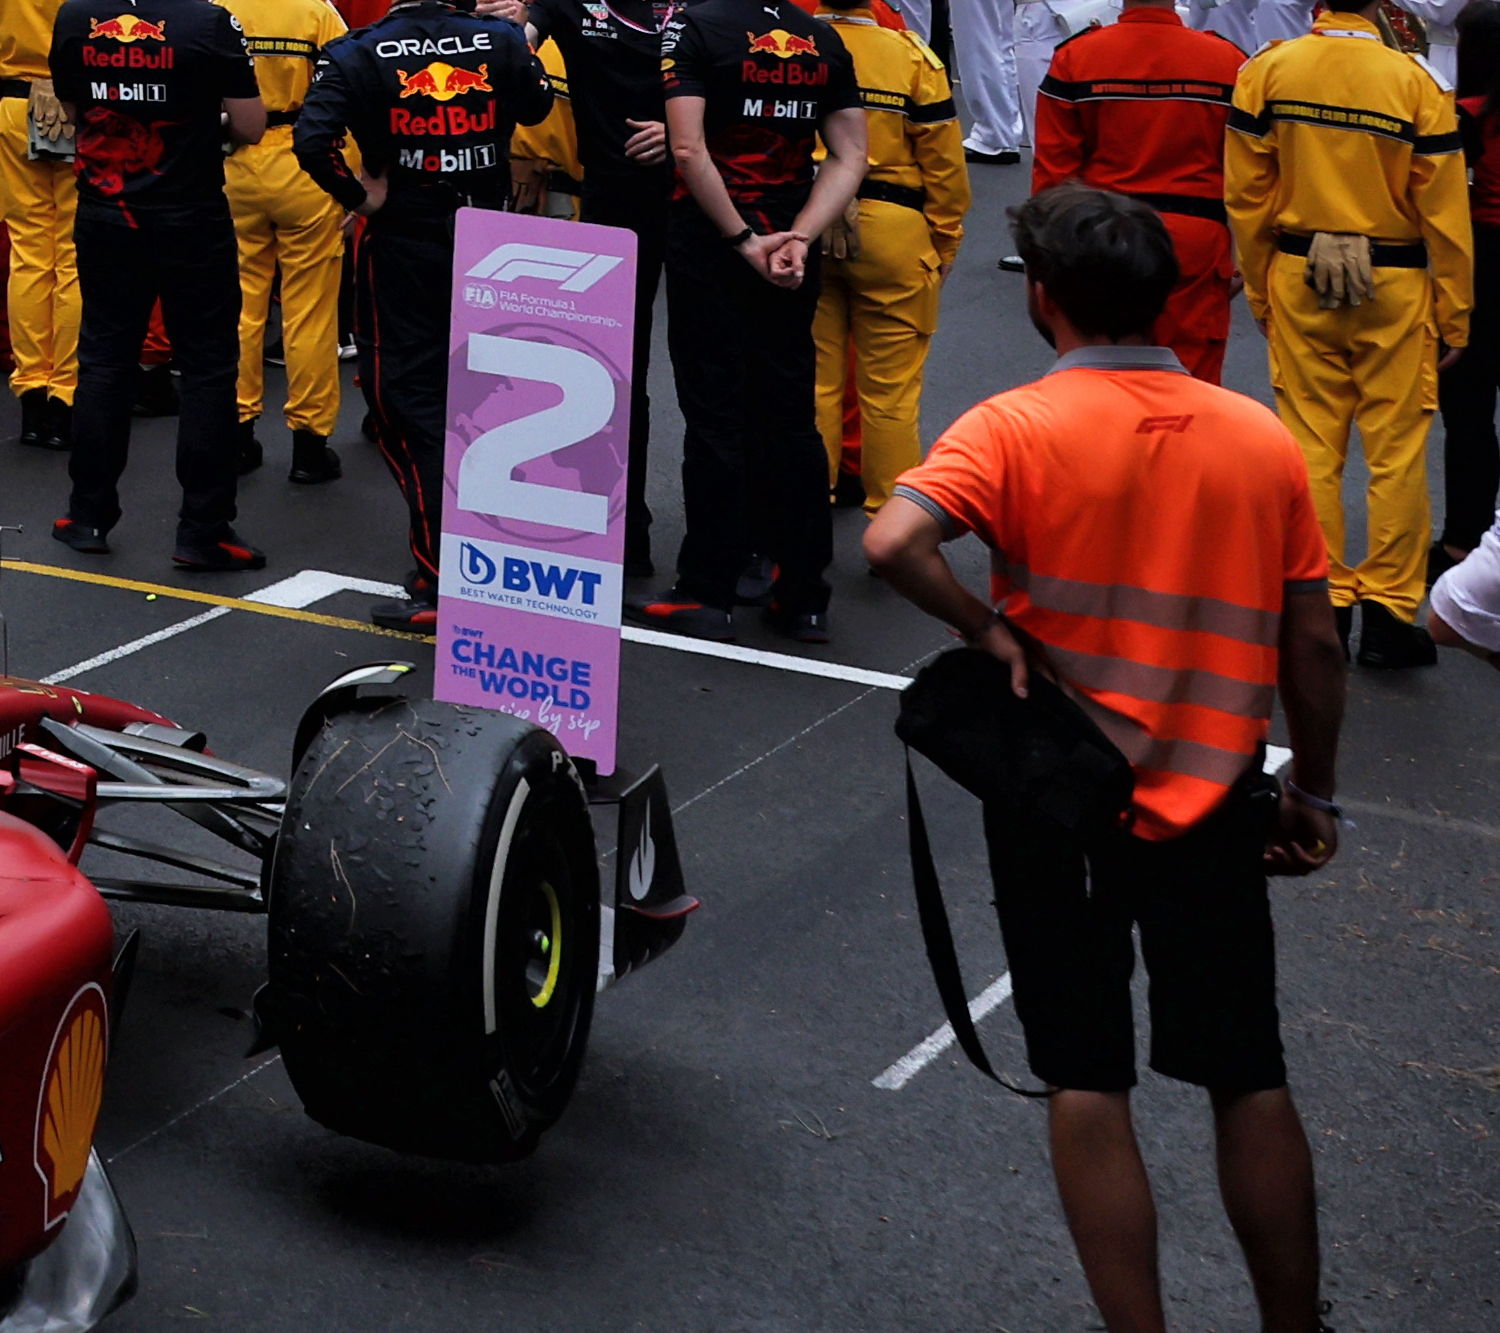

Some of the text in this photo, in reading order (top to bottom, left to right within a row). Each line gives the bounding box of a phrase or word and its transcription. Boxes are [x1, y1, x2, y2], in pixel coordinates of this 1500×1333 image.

[83, 45, 175, 70] Red Bull
[376, 32, 492, 59] ORACLE
[742, 61, 829, 86] Red Bull
[91, 81, 145, 102] Mobil
[867, 92, 905, 107] MONACO
[743, 99, 799, 118] Mobil
[390, 107, 447, 136] Red
[399, 147, 472, 173] Mobil
[465, 287, 494, 304] FIA
[500, 290, 519, 302] FIA
[520, 294, 569, 309] Formula
[500, 301, 534, 315] World
[456, 332, 615, 536] 2
[503, 556, 602, 606] BWT
[460, 586, 598, 620] BEST WATER TECHNOLOGY
[462, 627, 484, 639] BWT
[451, 638, 591, 687] CHANGE
[451, 664, 591, 711] THE WORLD
[568, 711, 600, 741] sip
